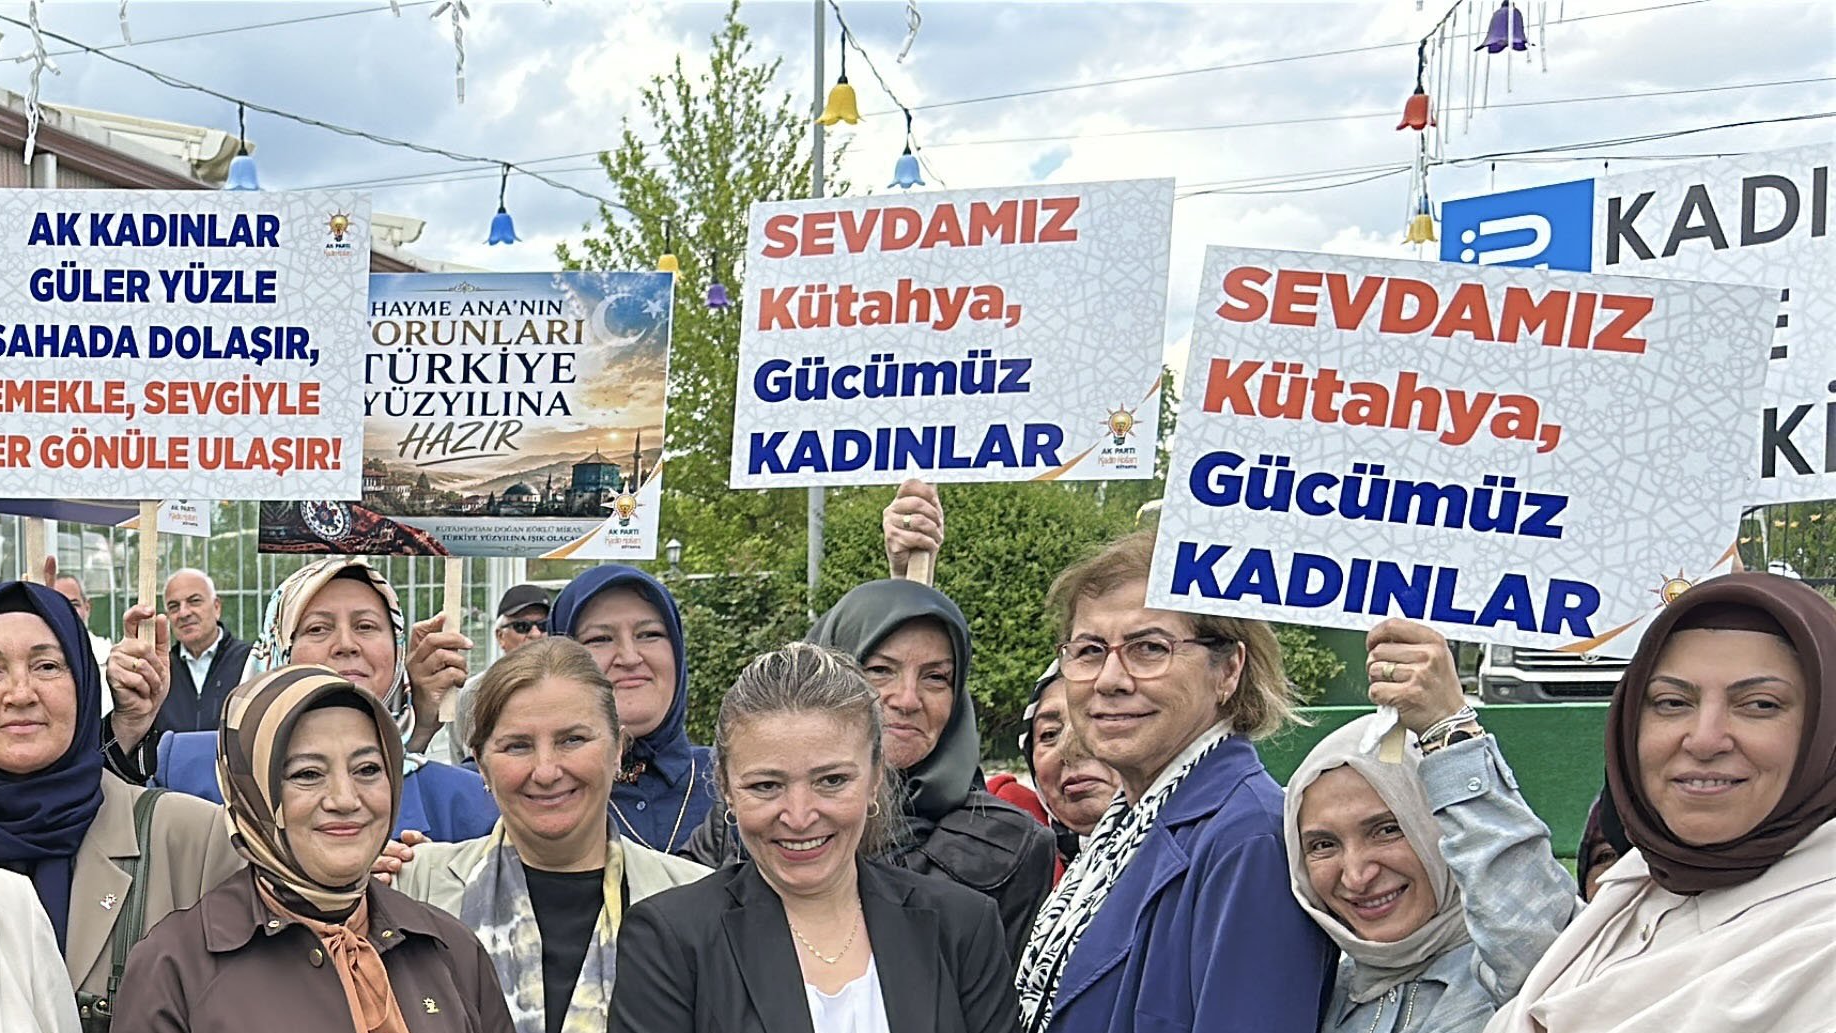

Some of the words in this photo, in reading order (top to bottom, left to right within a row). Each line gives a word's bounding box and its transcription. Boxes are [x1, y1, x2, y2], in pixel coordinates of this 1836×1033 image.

[27, 212, 81, 247] AK
[90, 213, 281, 248] KADINLAR
[761, 197, 1081, 259] SEVDAMIZ
[29, 262, 150, 303] GÜLER
[158, 262, 278, 304] YÜZLE
[758, 279, 1023, 332] Kütahya,
[367, 319, 585, 346] ORUNLARI
[371, 301, 451, 316] HAYME
[1216, 266, 1655, 354] SEVDAMIZ
[149, 325, 321, 366] DOLAŞIR,
[144, 374, 321, 415] SEVGİYLE
[752, 350, 1033, 403] Gücümüz
[1202, 358, 1562, 453] Kütahya,
[40, 428, 189, 470] GÖNÜLE
[198, 437, 342, 477] ULAŞIR!
[397, 420, 523, 460] HAZIR
[748, 423, 1065, 475] KADINLAR
[1189, 451, 1569, 540] Gücümüz
[1169, 540, 1602, 639] KADINLAR
